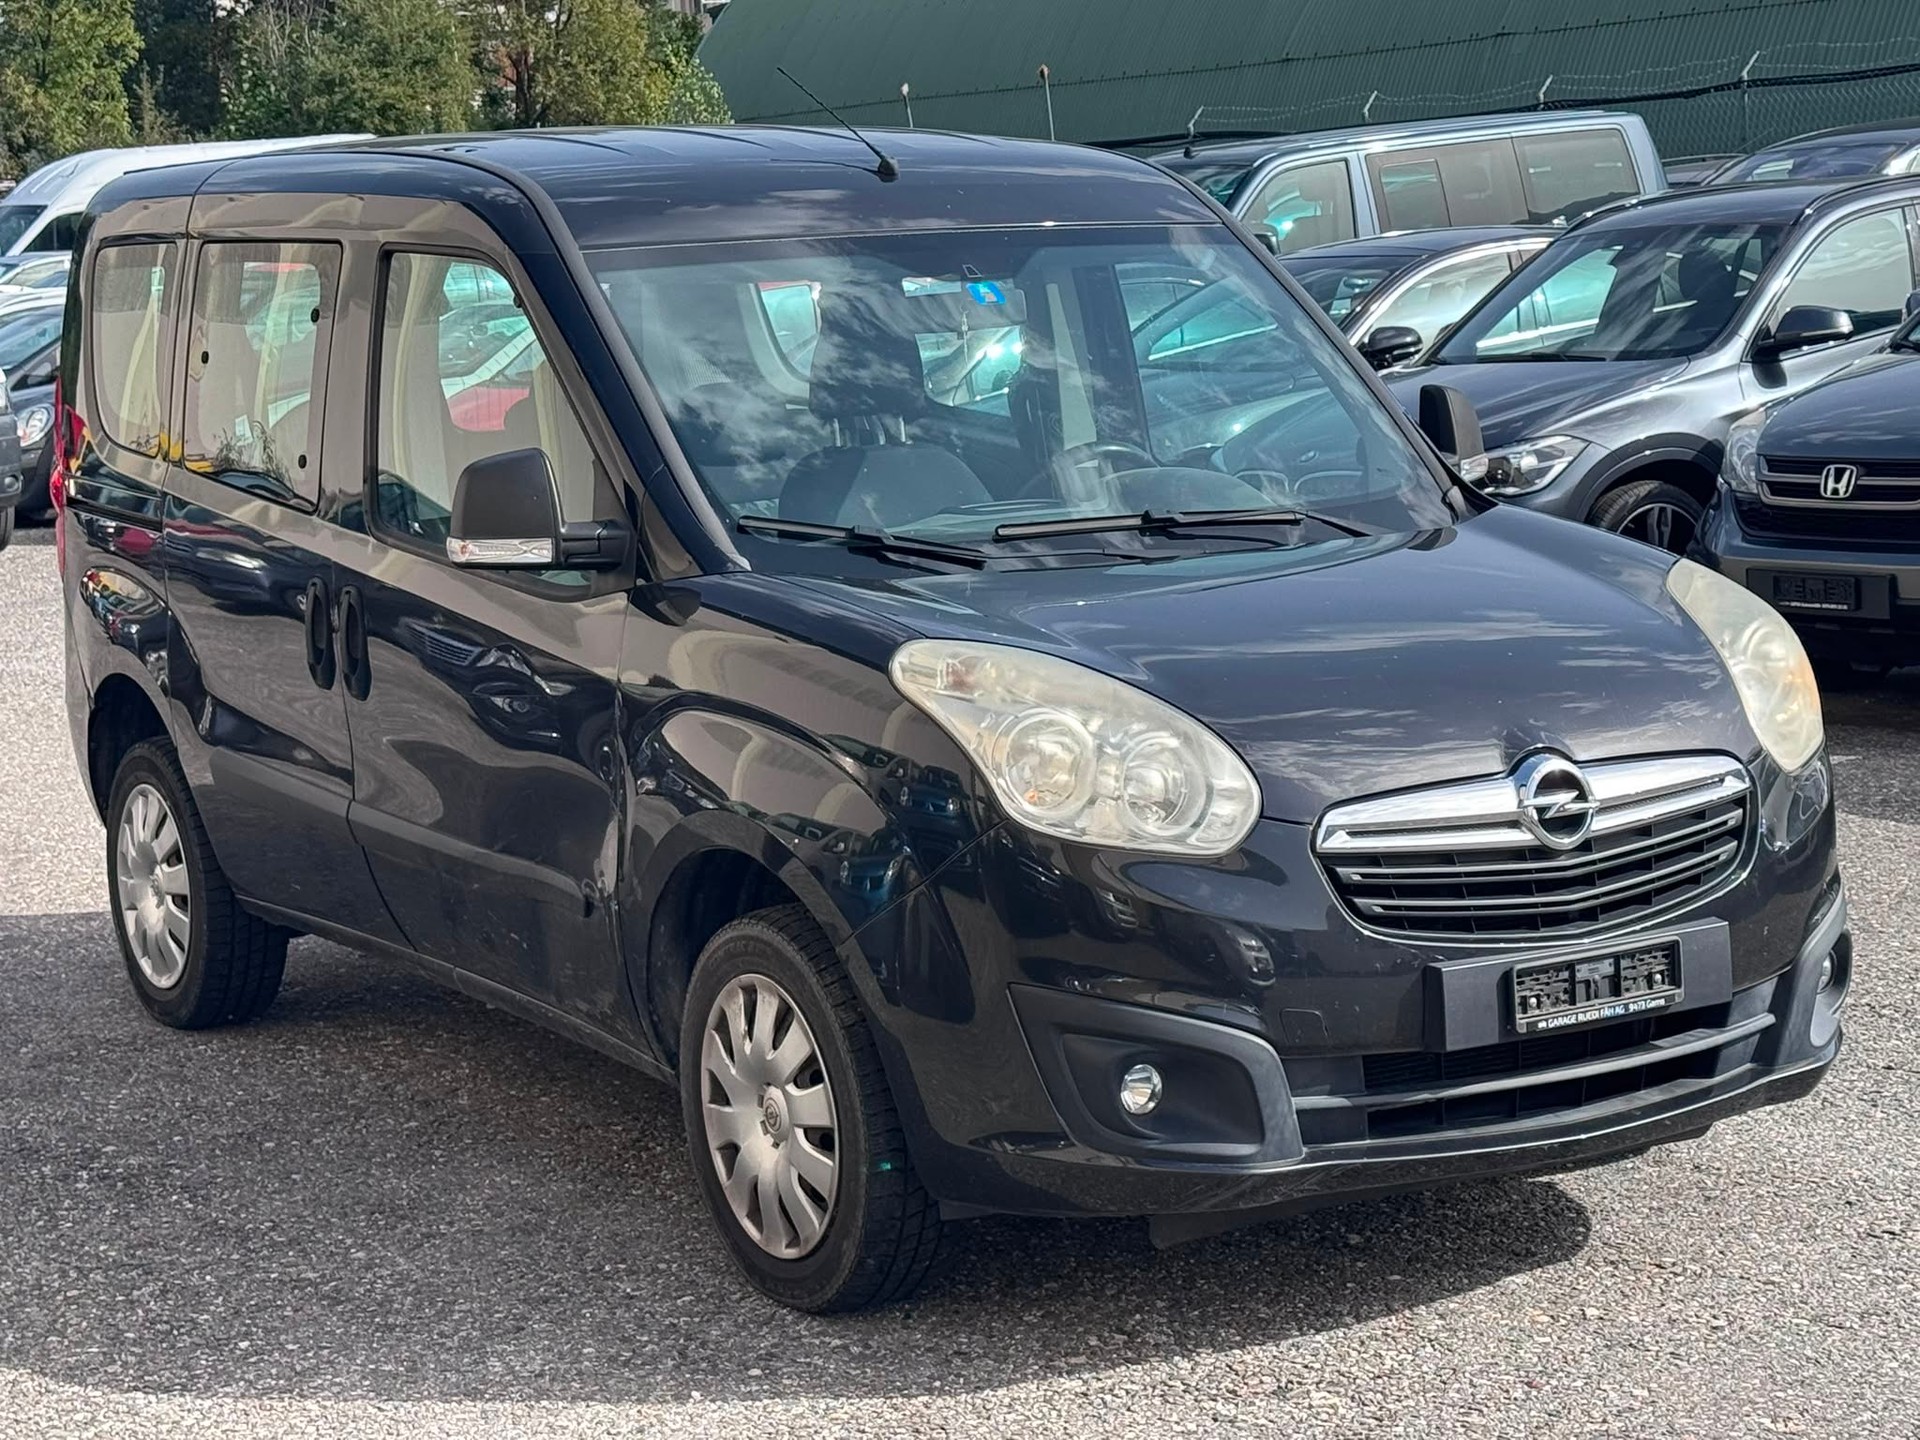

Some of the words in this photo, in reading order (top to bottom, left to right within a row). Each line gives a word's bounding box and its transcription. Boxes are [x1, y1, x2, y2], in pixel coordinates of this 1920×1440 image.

[1548, 1014, 1577, 1028] GARAGE
[1578, 1010, 1600, 1022] RUEDI
[1615, 1004, 1625, 1015] AG
